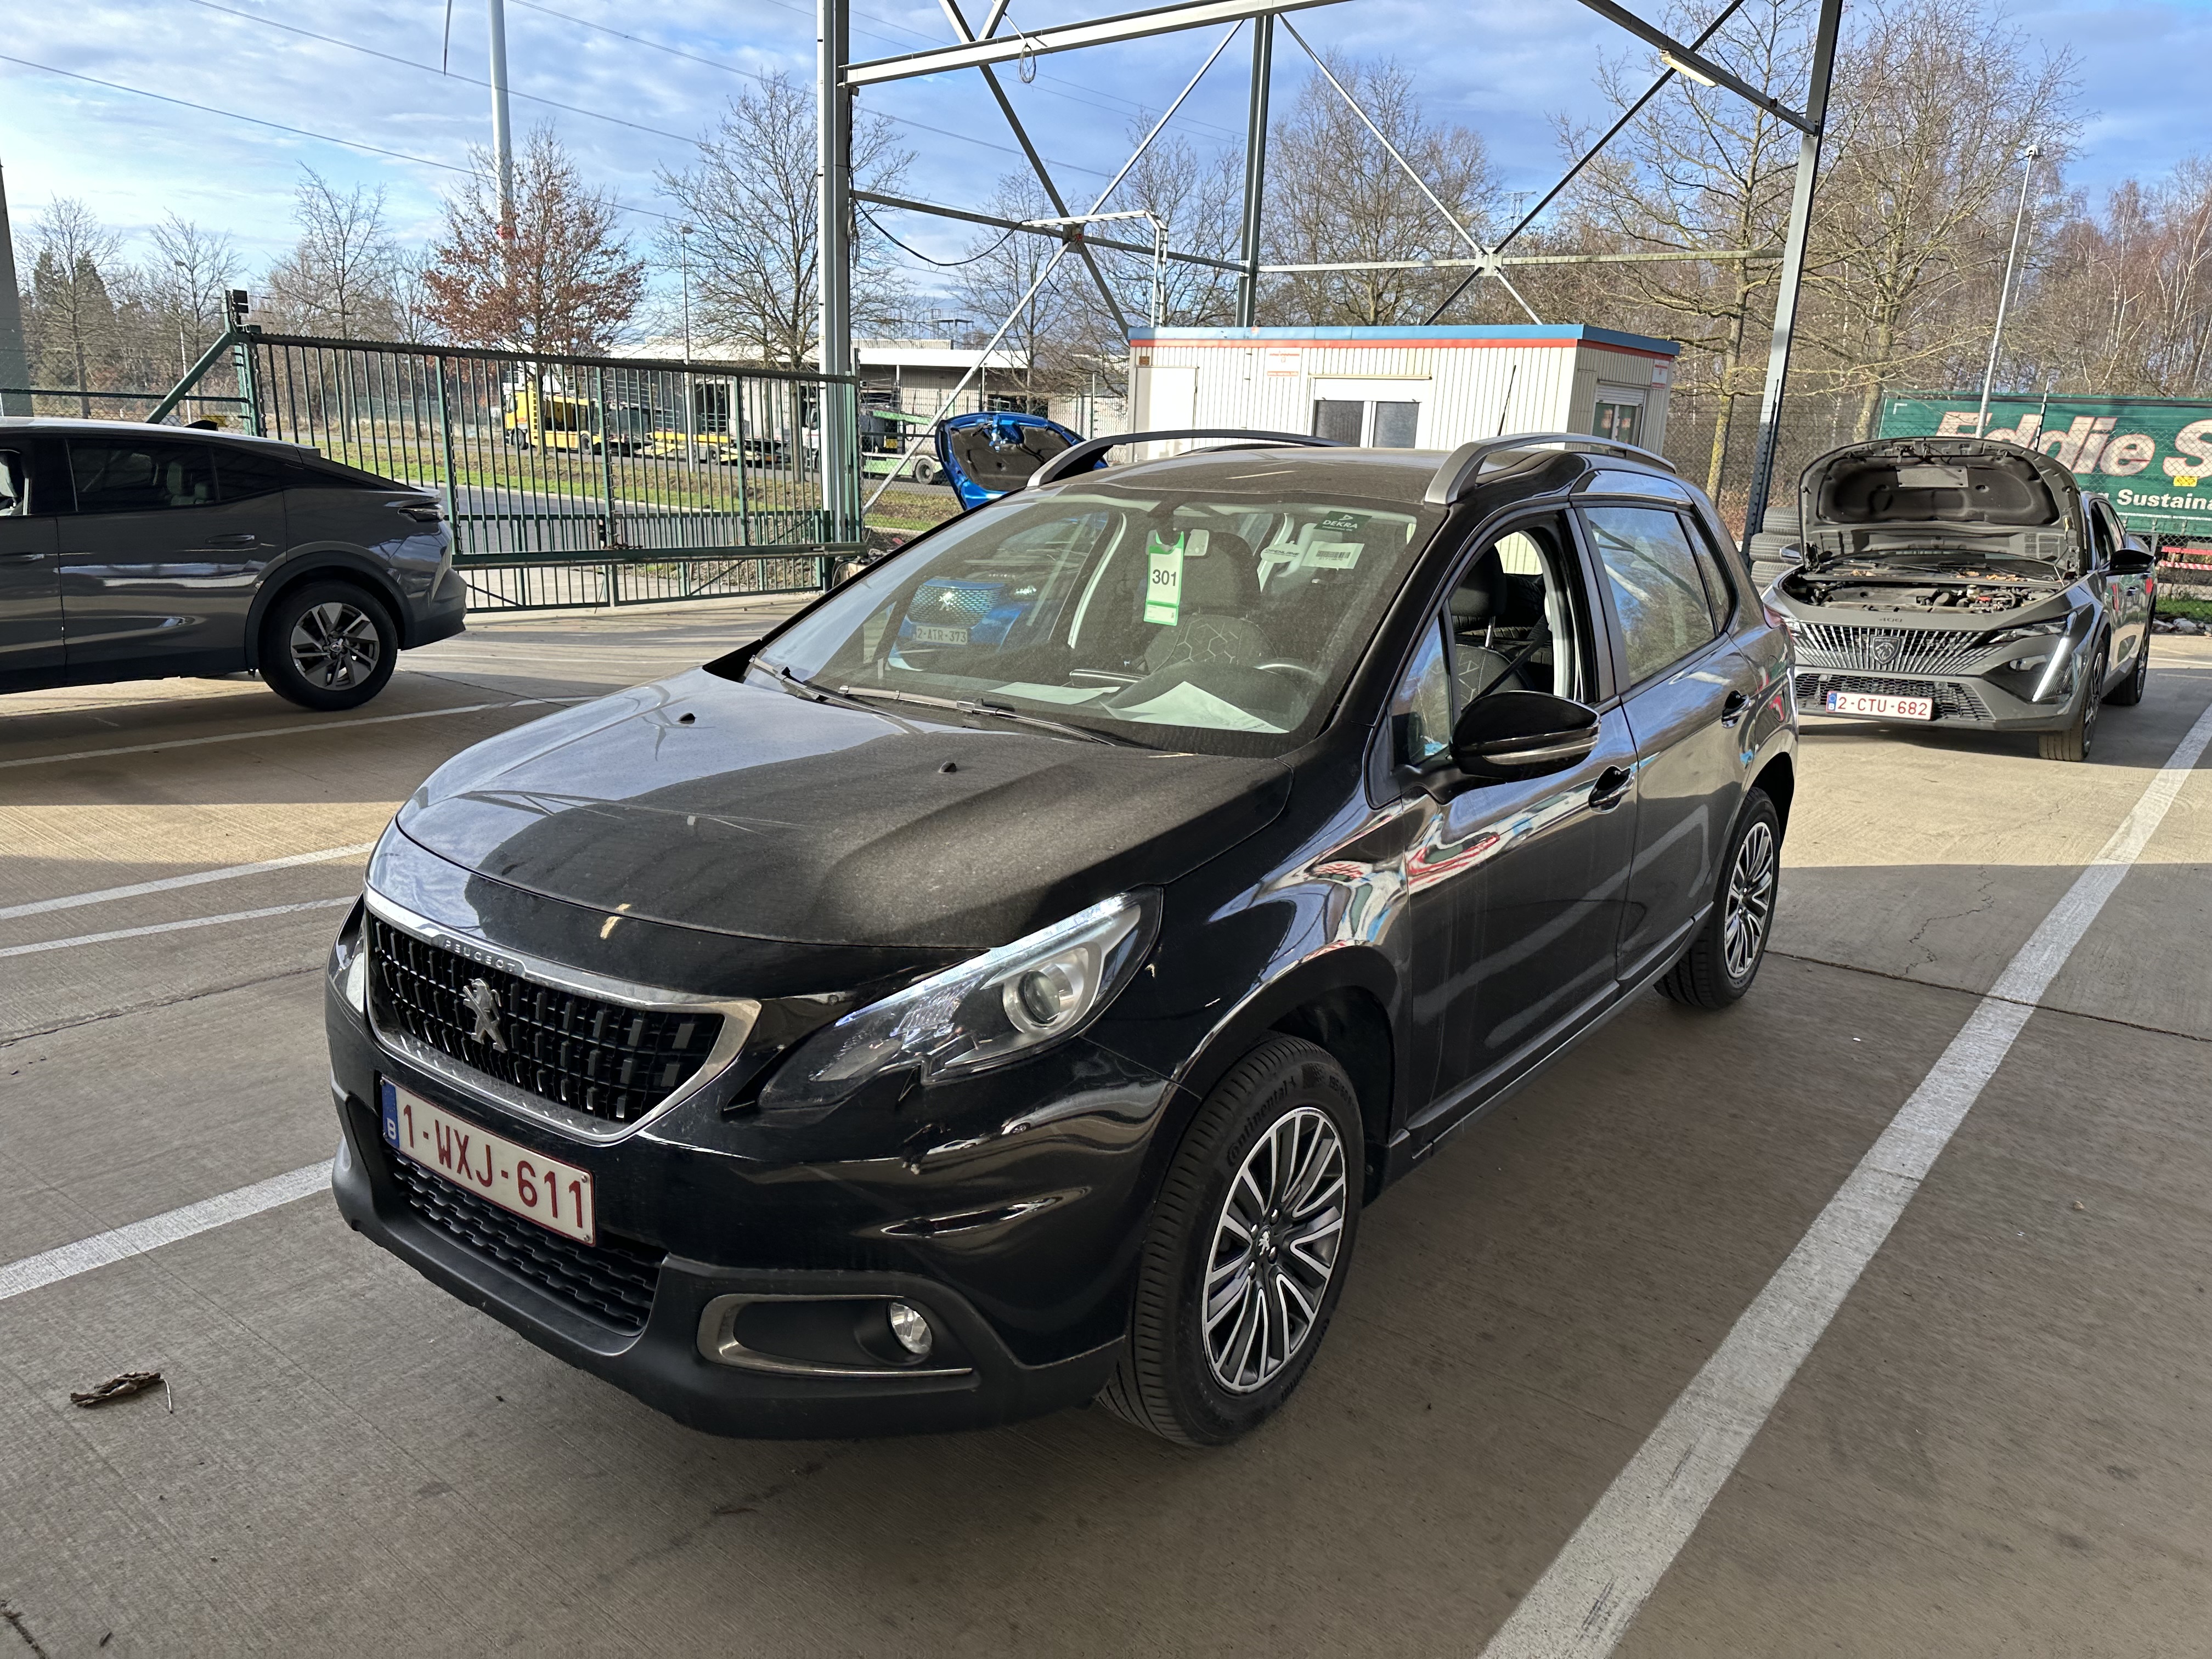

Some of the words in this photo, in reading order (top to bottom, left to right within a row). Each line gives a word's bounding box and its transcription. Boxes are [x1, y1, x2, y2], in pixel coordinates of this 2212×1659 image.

[1322, 520, 1358, 529] DEKRA
[1152, 569, 1177, 586] 301
[917, 628, 966, 642] 2-ATR-373
[1837, 696, 1928, 716] 2-CTU-682
[445, 940, 516, 972] PEUGEOT
[387, 1117, 396, 1140] B
[403, 1104, 583, 1229] 1-WXJ-611
